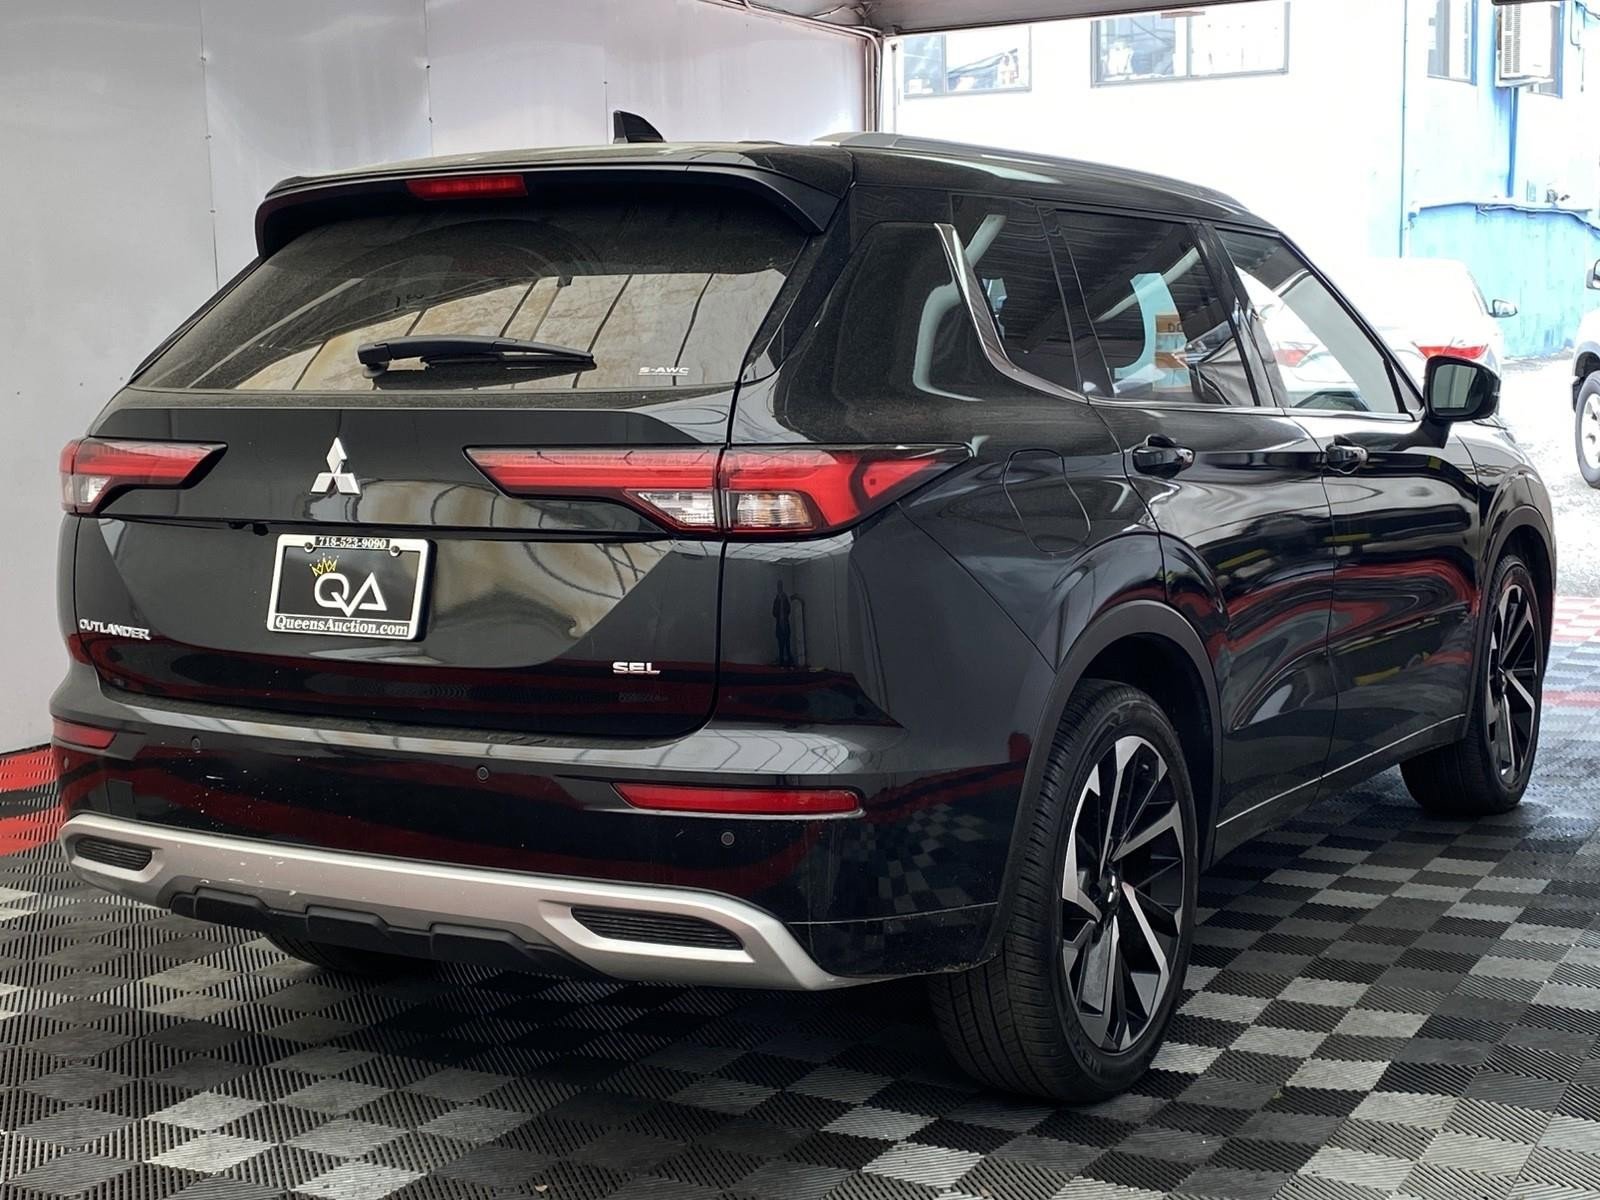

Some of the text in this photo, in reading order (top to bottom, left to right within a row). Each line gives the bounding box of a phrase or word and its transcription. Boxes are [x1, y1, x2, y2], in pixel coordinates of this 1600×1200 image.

[318, 536, 387, 549] 718-523-9090
[79, 618, 151, 641] OUTLANDER
[275, 614, 409, 636] QueensAuction.com
[612, 661, 661, 675] SEL
